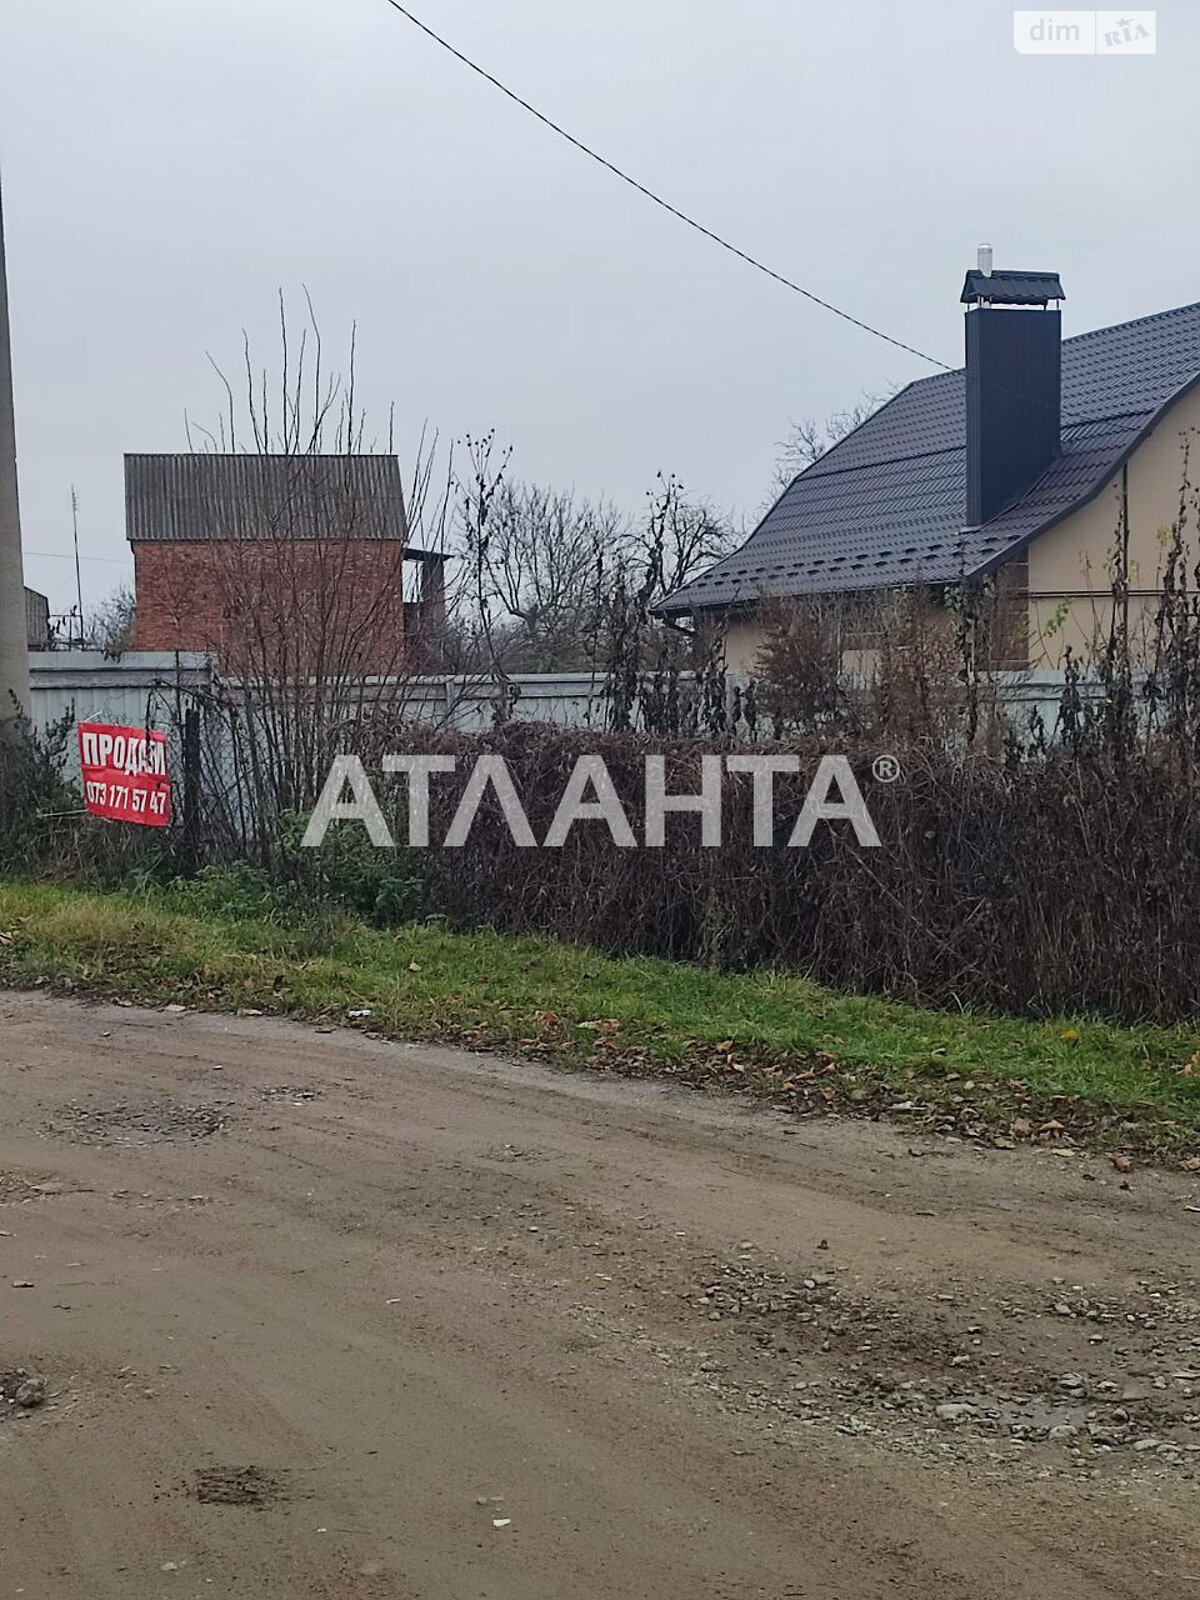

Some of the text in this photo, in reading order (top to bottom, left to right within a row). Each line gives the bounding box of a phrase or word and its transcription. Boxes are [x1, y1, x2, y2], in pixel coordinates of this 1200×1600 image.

[82, 732, 166, 777] ПРОДАМ
[86, 781, 166, 815] 073 171 57 47
